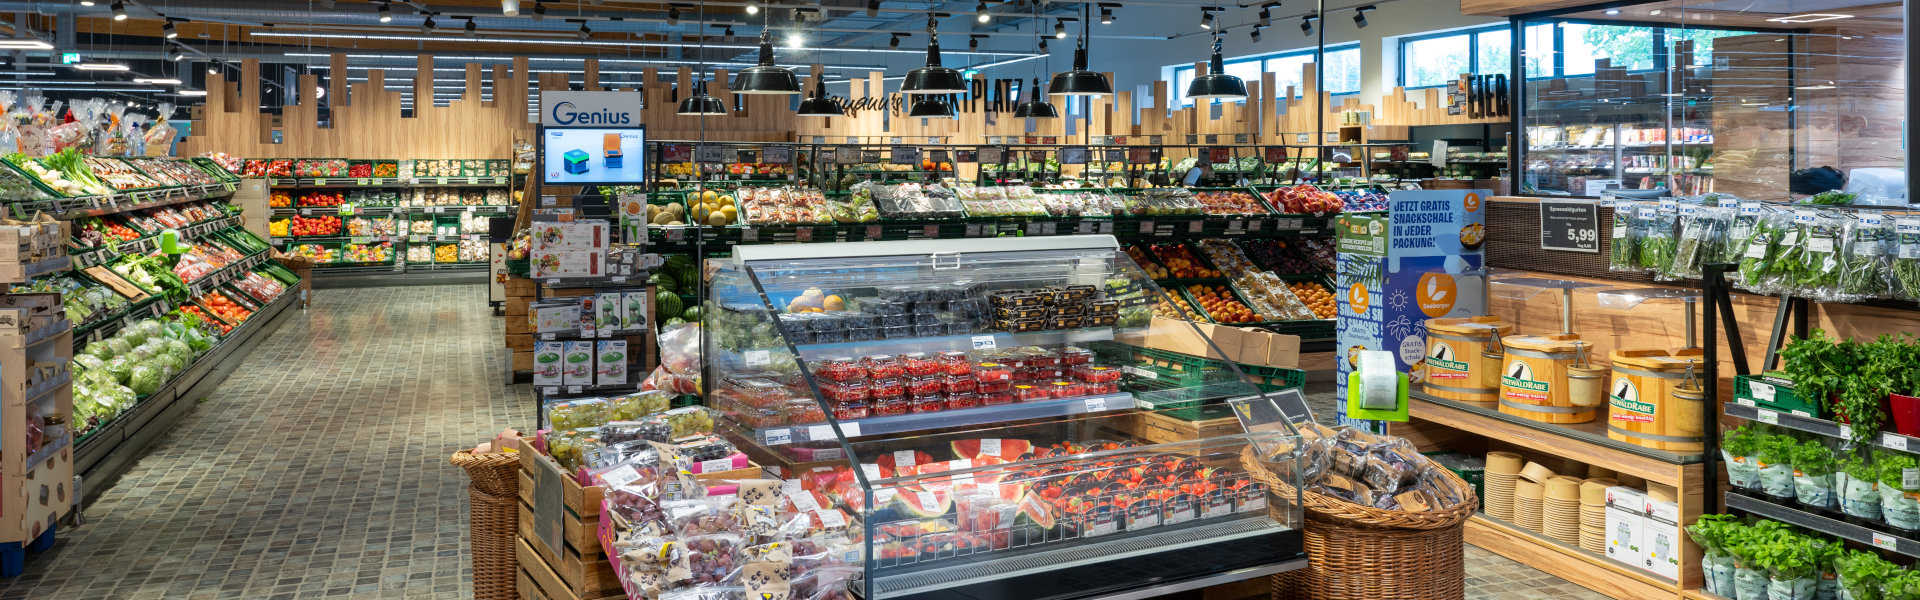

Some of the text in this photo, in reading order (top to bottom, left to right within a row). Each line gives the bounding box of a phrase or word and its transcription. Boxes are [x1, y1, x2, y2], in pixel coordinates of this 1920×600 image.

[553, 101, 630, 125] Genius
[1394, 200, 1450, 211] JETZT GRATIS
[1393, 213, 1453, 224] SNACKSCHALE
[1393, 225, 1431, 236] IN JEDER
[1567, 228, 1596, 243] 5,99
[1393, 237, 1435, 248] PACKUNG!
